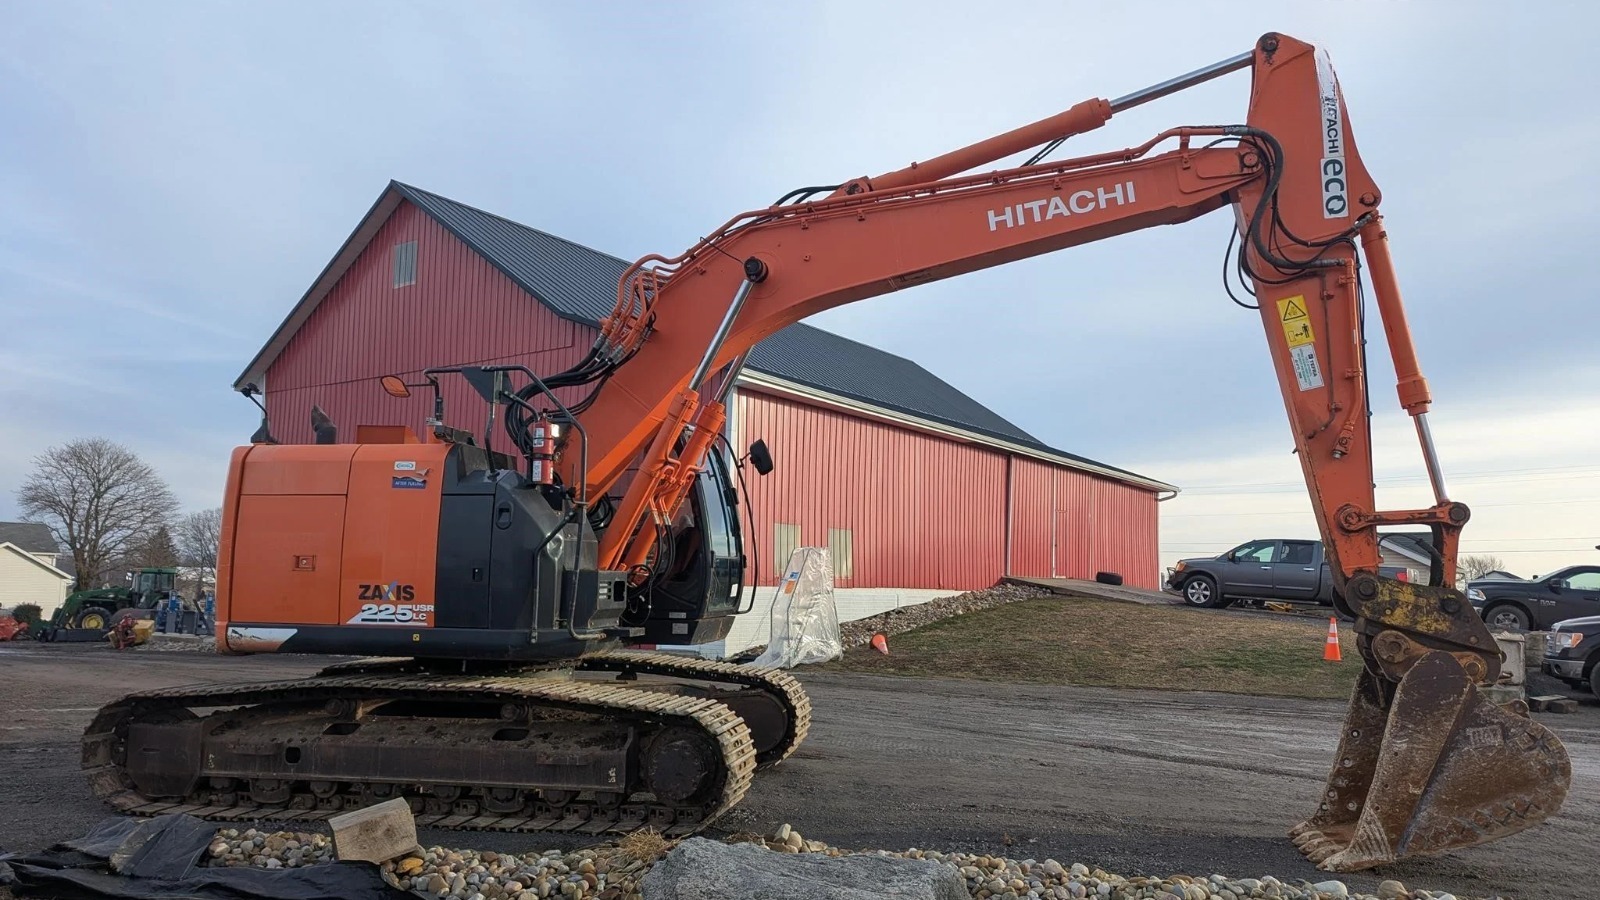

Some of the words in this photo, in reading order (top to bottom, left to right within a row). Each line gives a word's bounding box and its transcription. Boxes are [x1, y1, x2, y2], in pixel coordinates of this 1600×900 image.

[987, 181, 1136, 231] HITACHI
[358, 581, 415, 601] ZAXIS
[360, 604, 413, 622] 225
[412, 604, 434, 612] USR
